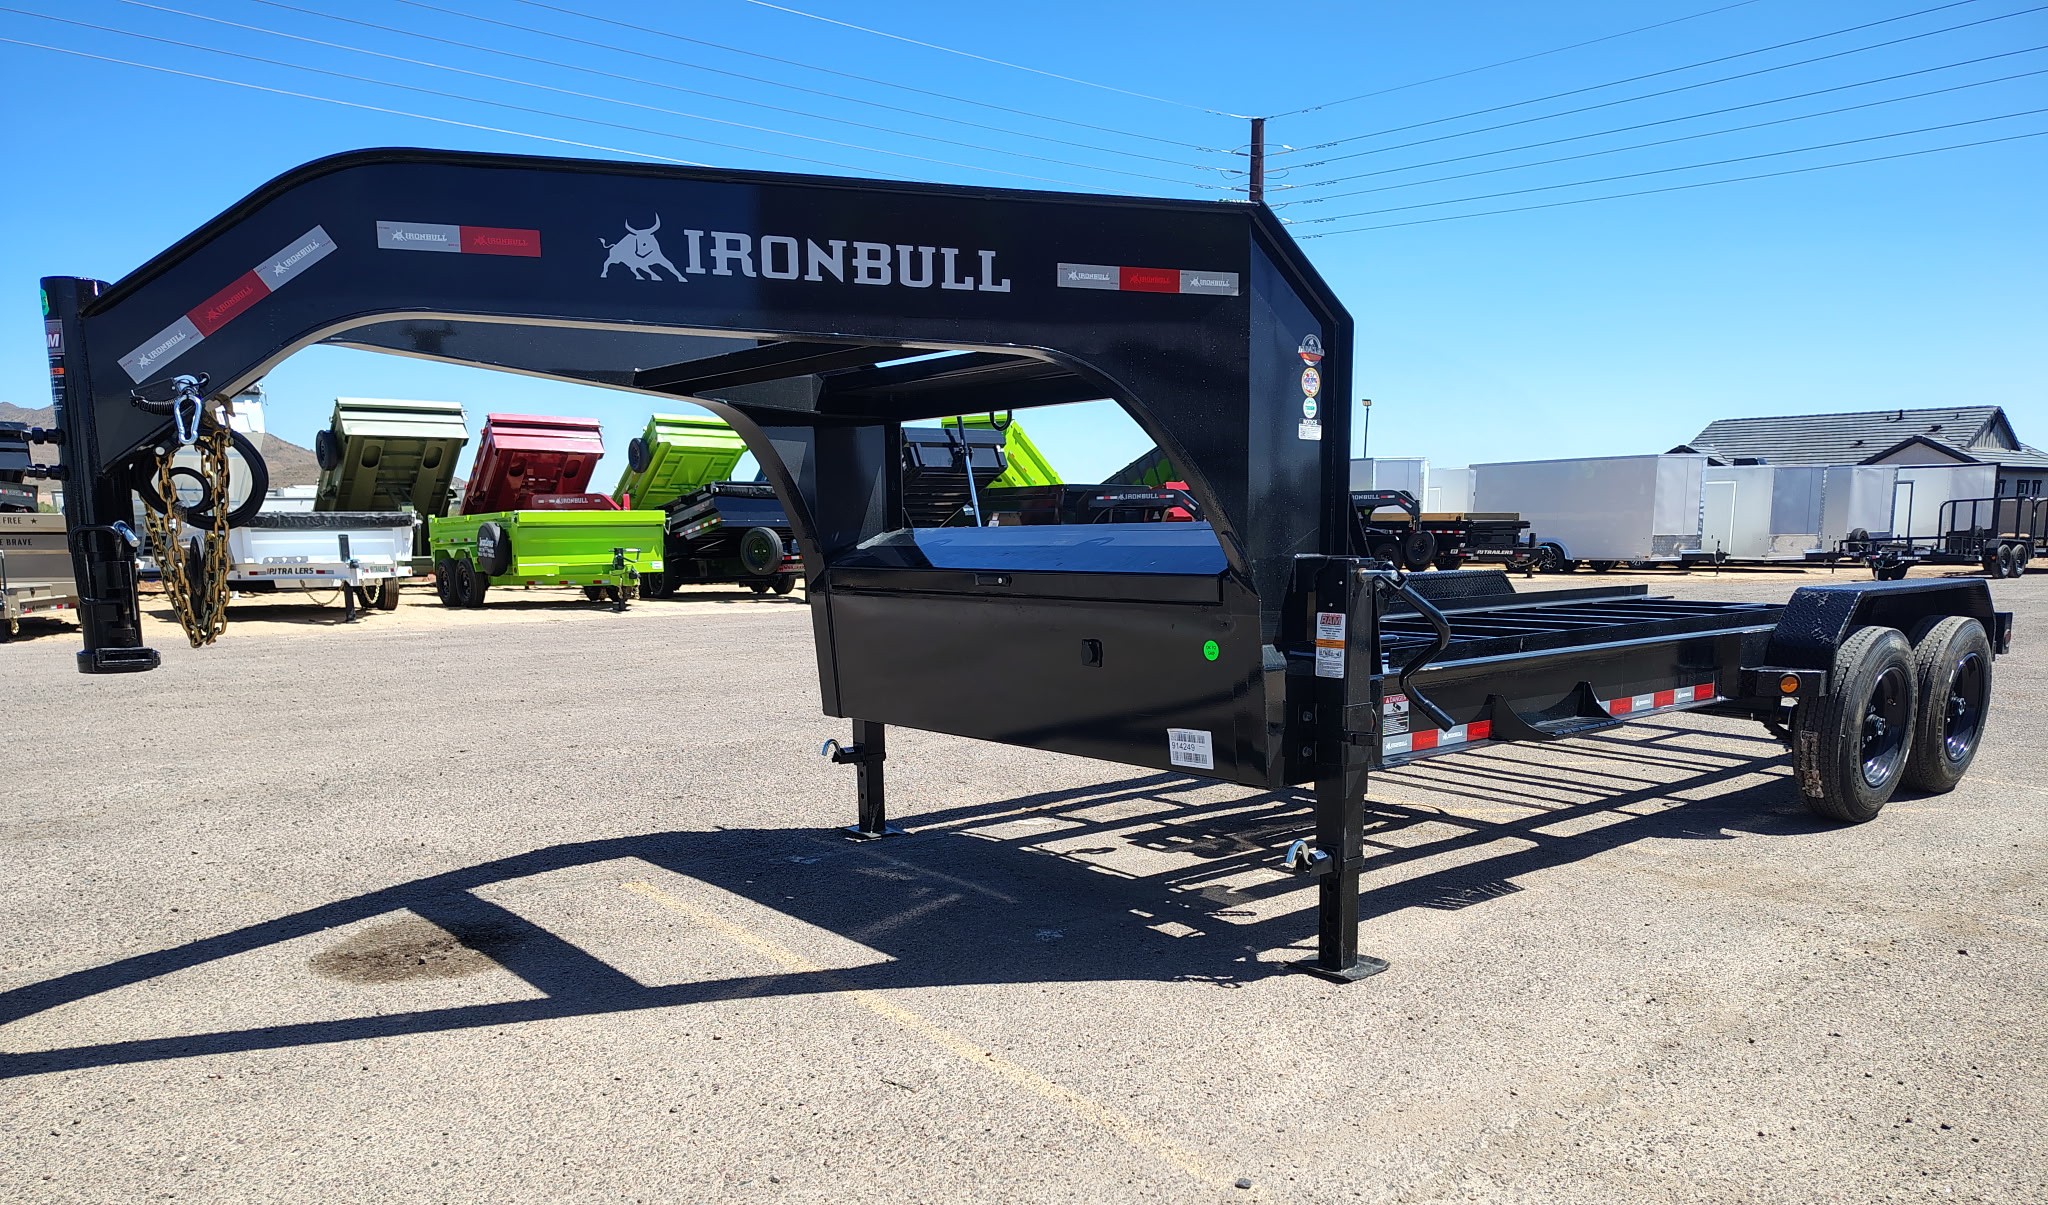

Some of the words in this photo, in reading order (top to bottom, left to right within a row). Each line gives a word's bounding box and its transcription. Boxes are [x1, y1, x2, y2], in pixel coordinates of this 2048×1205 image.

[405, 232, 448, 242] IRONBULL
[487, 237, 529, 247] IRONBULL
[283, 238, 320, 269] IRONBULL
[684, 229, 1011, 293] IRONBULL
[1078, 272, 1111, 281] IRONBULL
[1199, 279, 1230, 287] IRONBULL
[216, 286, 254, 313] IRONBULL
[149, 330, 187, 361] IRONBULL
[2, 517, 22, 525] FREE
[6, 538, 32, 546] BRAVE
[278, 567, 314, 575] TRALERS
[1321, 616, 1342, 625] RAM
[1171, 741, 1195, 751] 914249
